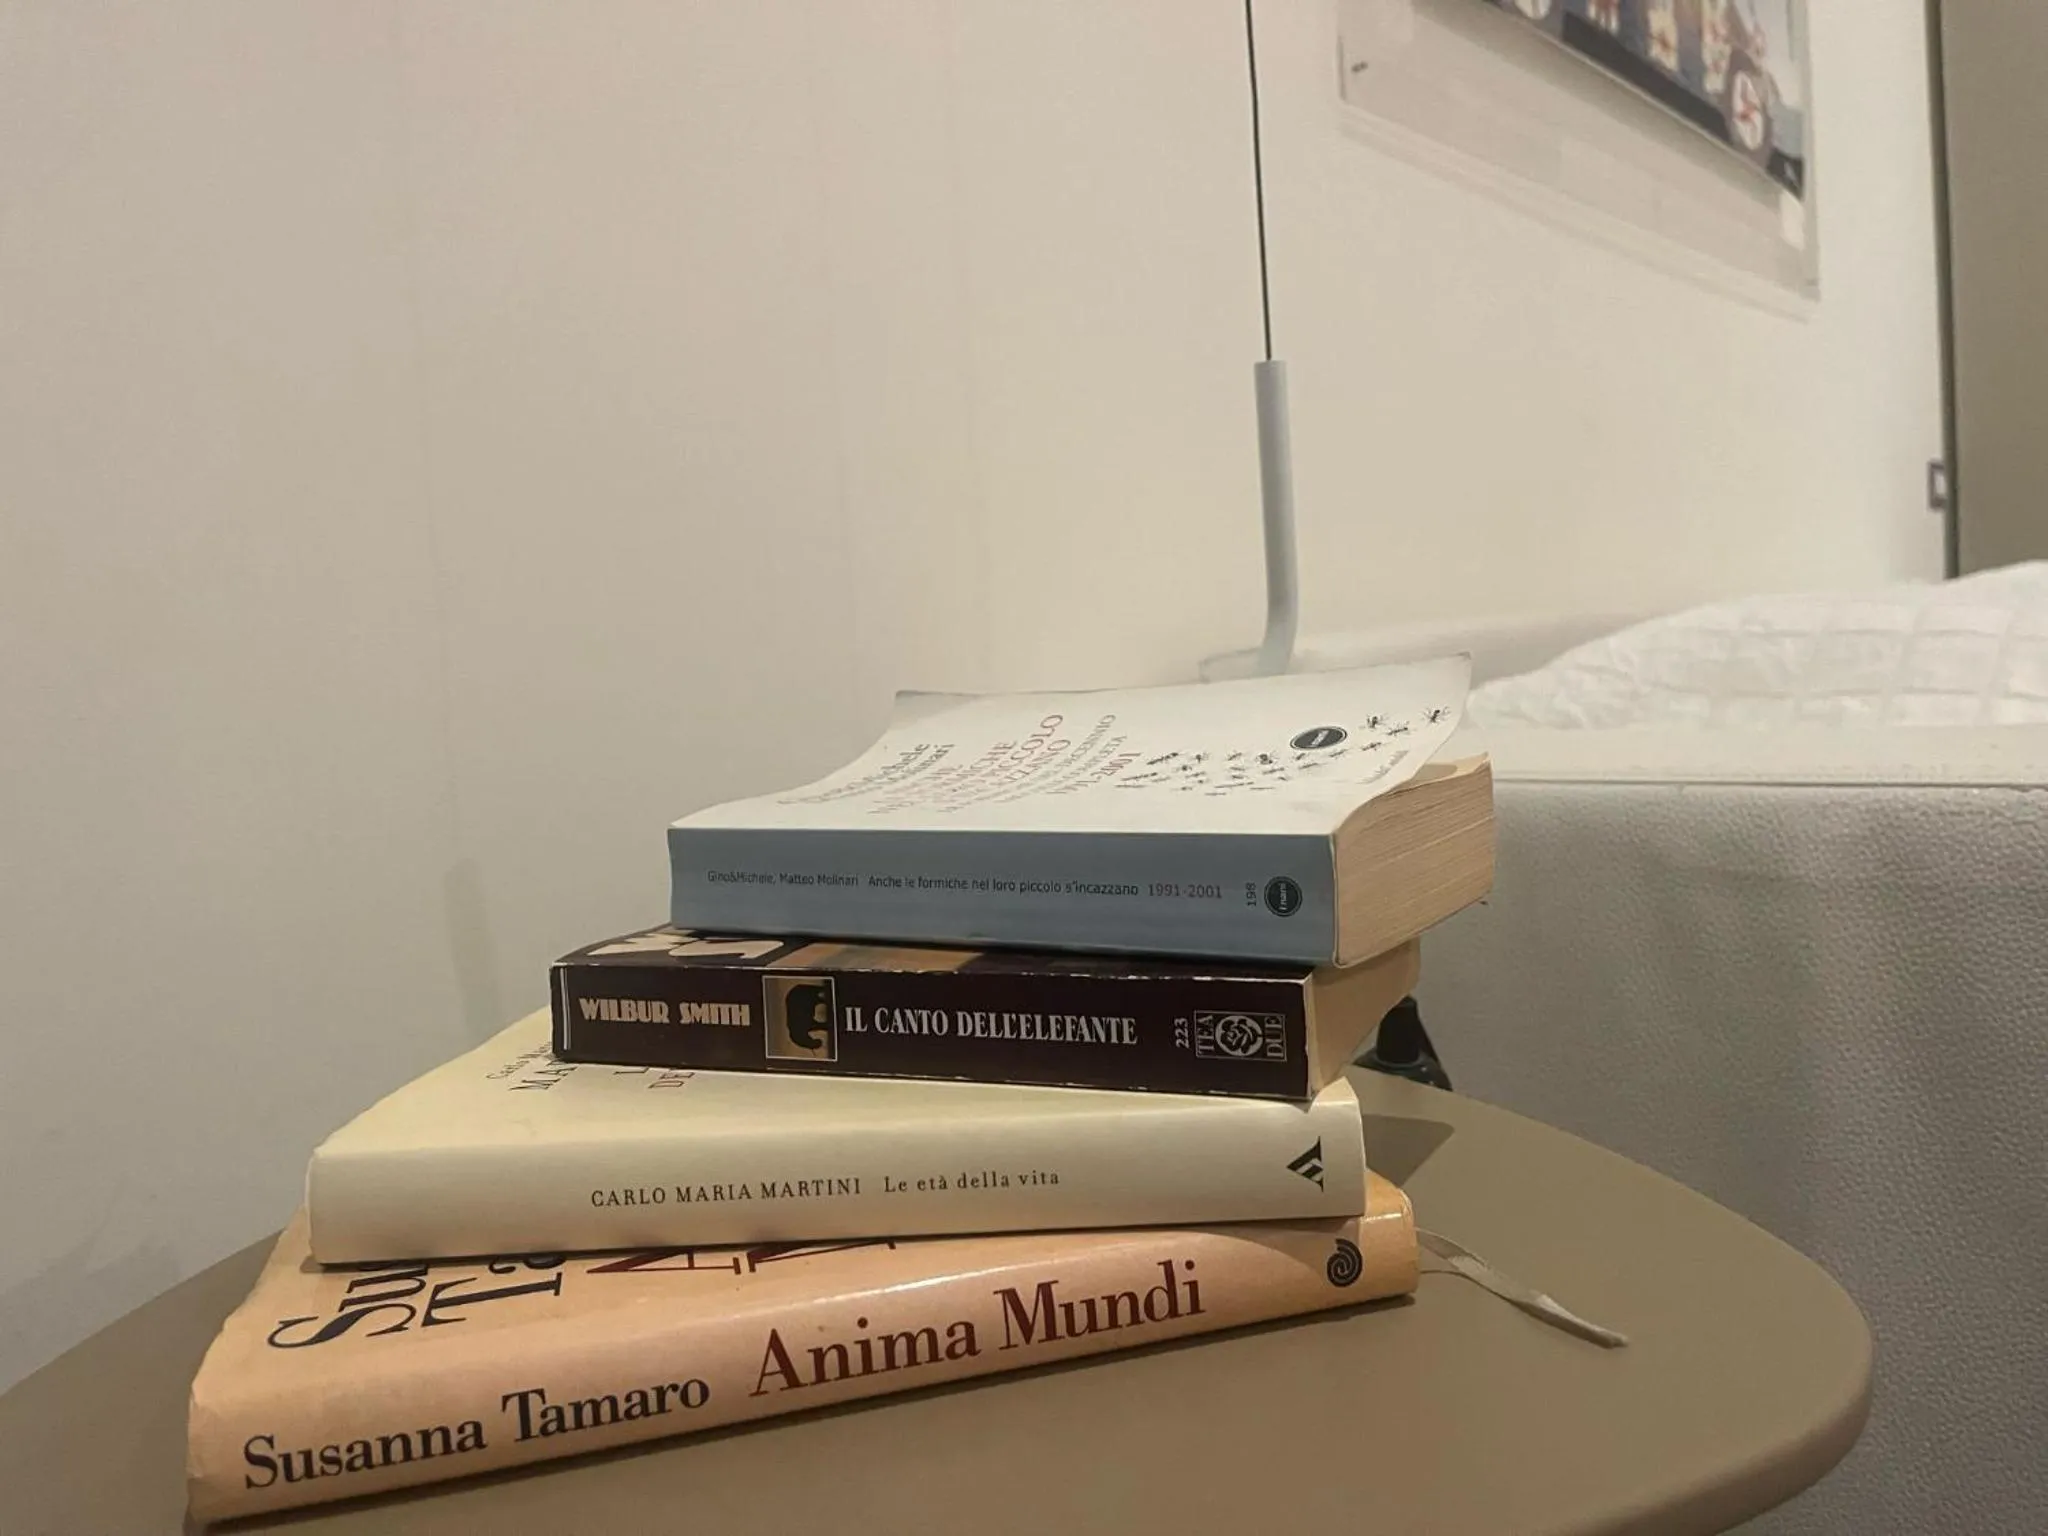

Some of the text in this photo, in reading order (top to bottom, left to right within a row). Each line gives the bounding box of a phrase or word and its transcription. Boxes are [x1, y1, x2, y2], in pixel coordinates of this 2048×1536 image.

[707, 870, 1223, 899] Gino&Michele, Matteo Molinari Anche le formiche nel loro piccolo s'incazzano 1991-2001
[1245, 882, 1257, 907] 198
[578, 997, 751, 1027] WILBUR SMITH
[844, 1006, 1139, 1045] IL CANTO DELL'ELEFANTE
[1174, 1017, 1191, 1049] 223
[1197, 1014, 1215, 1055] TEA
[1264, 1015, 1285, 1058] DUE
[590, 1169, 1060, 1208] CARLO MARIA MARTINI Le età della vita
[243, 1257, 1207, 1490] Susanna Tamaro Anima Mundi
